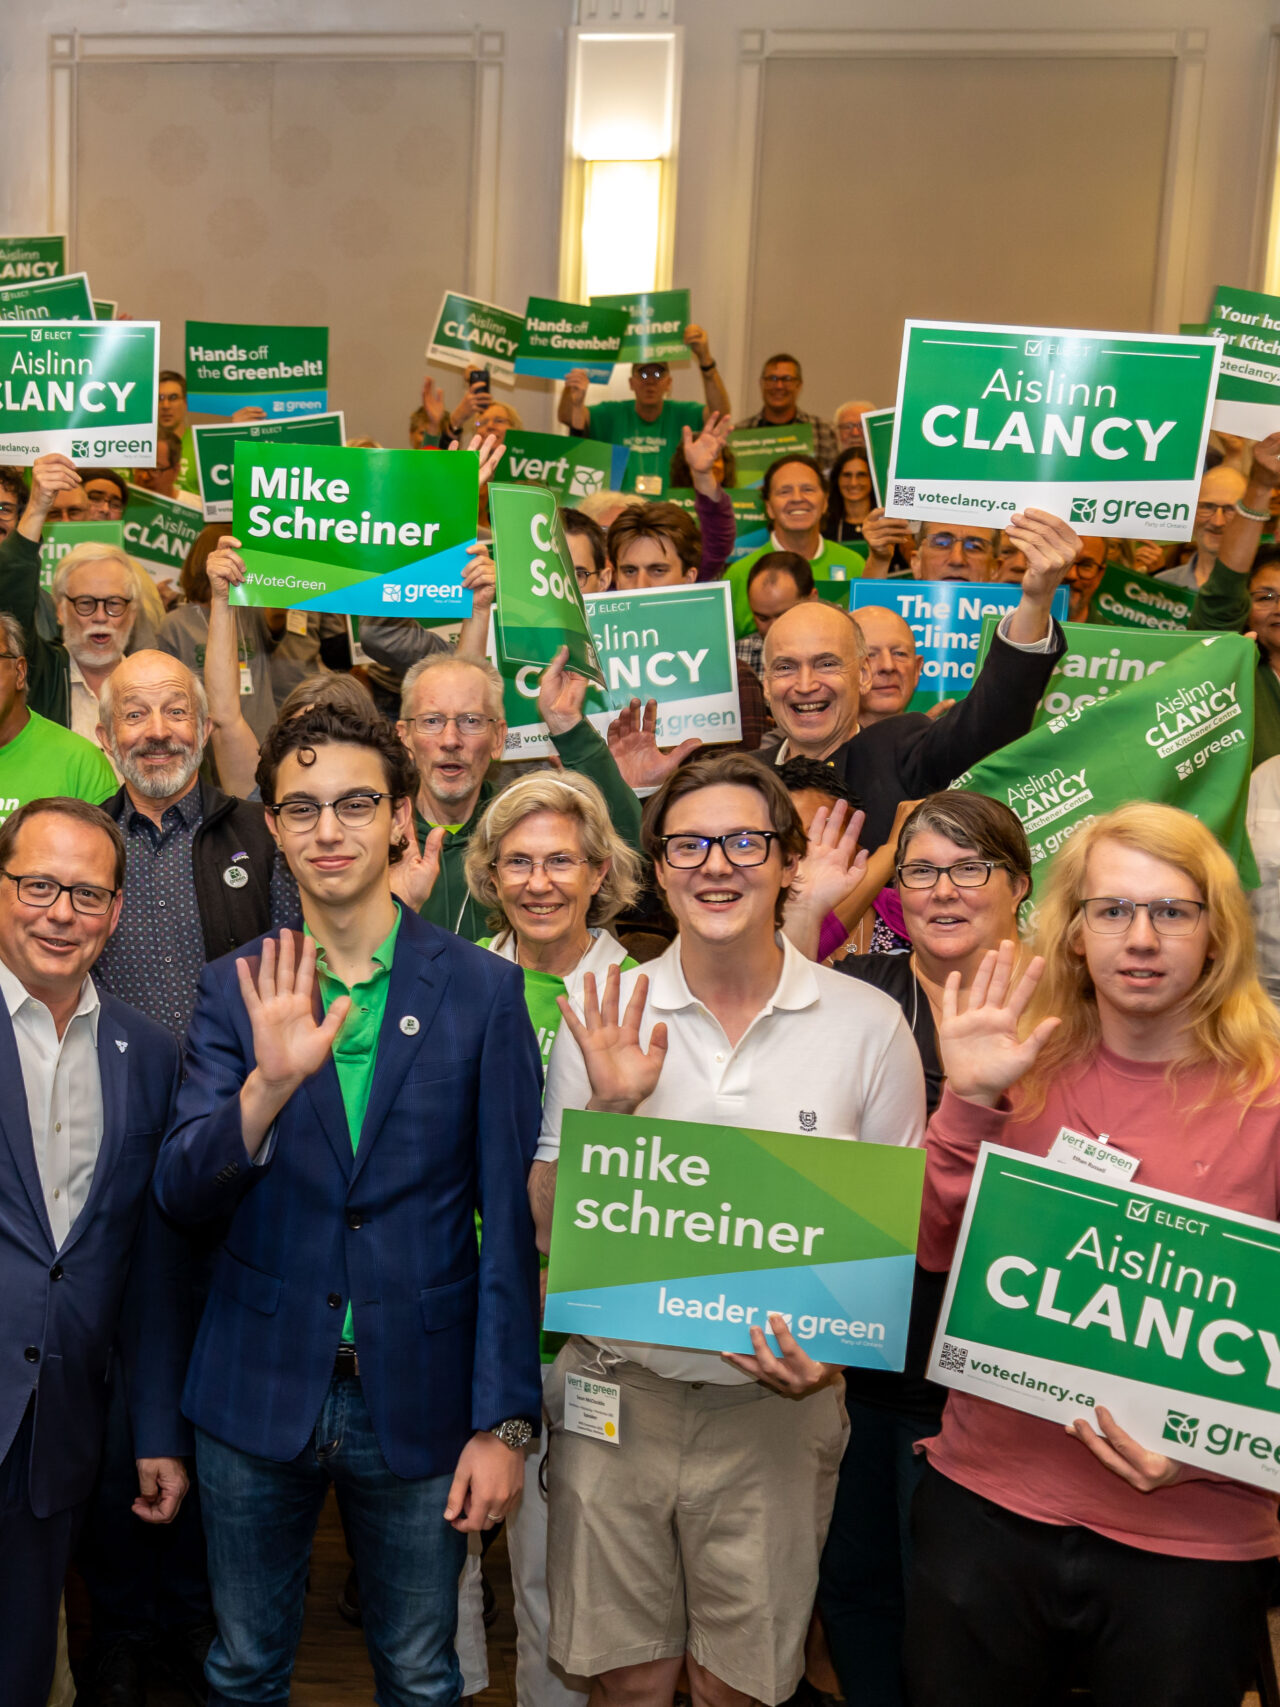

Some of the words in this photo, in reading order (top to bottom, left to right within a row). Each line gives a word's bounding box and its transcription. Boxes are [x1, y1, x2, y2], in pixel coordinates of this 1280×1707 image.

[466, 312, 507, 335] Aislinn
[526, 318, 573, 334] Hands
[573, 321, 589, 334] off
[1220, 305, 1259, 326] Your
[44, 330, 72, 340] ELECT
[443, 320, 518, 358] CLANCY
[529, 334, 549, 347] the
[550, 335, 621, 351] Greenbelt!
[11, 349, 94, 376] Aislinn
[189, 345, 247, 362] Hands
[248, 345, 269, 361] off
[197, 365, 221, 379] the
[223, 360, 324, 381] Greenbelt!
[1220, 360, 1280, 383] oteclancy.
[286, 400, 322, 412] green
[981, 368, 1117, 408] Aislinn
[94, 440, 153, 458] green
[921, 404, 1178, 462] CLANCY
[251, 466, 350, 504] Mike
[509, 456, 570, 484] vert
[918, 491, 1017, 512] voteclancy.ca
[1102, 496, 1190, 524] green
[124, 521, 190, 560] CLAN
[247, 505, 440, 547] Schreiner
[246, 573, 326, 591] #VoteGreen
[404, 583, 463, 603] green
[1124, 582, 1192, 618] Caring.
[599, 602, 632, 614] ELECT
[897, 594, 950, 619] The
[1099, 594, 1188, 631] Connecte
[1145, 682, 1237, 747] CLANCY
[1156, 680, 1216, 722] Aislinn
[668, 708, 736, 736] green
[1161, 743, 1174, 756] for
[1175, 722, 1212, 749] Kitchener
[1213, 707, 1238, 726] Centre
[1194, 728, 1246, 768] green
[1007, 768, 1065, 806] Aislinn
[1010, 768, 1087, 823] LANCY
[1025, 810, 1063, 832] Kitchener
[1063, 793, 1089, 812] Centre
[580, 1136, 710, 1187] mike
[1062, 1132, 1086, 1149] vert
[1096, 1149, 1133, 1171] green
[573, 1190, 825, 1256] schreiner
[1155, 1210, 1210, 1237] ELECT
[1066, 1226, 1238, 1308] Aislinn
[657, 1287, 759, 1326] leader
[797, 1313, 886, 1341] green
[567, 1375, 583, 1388] vert
[592, 1383, 618, 1397] green
[970, 1357, 1097, 1408] voteclancy.ca
